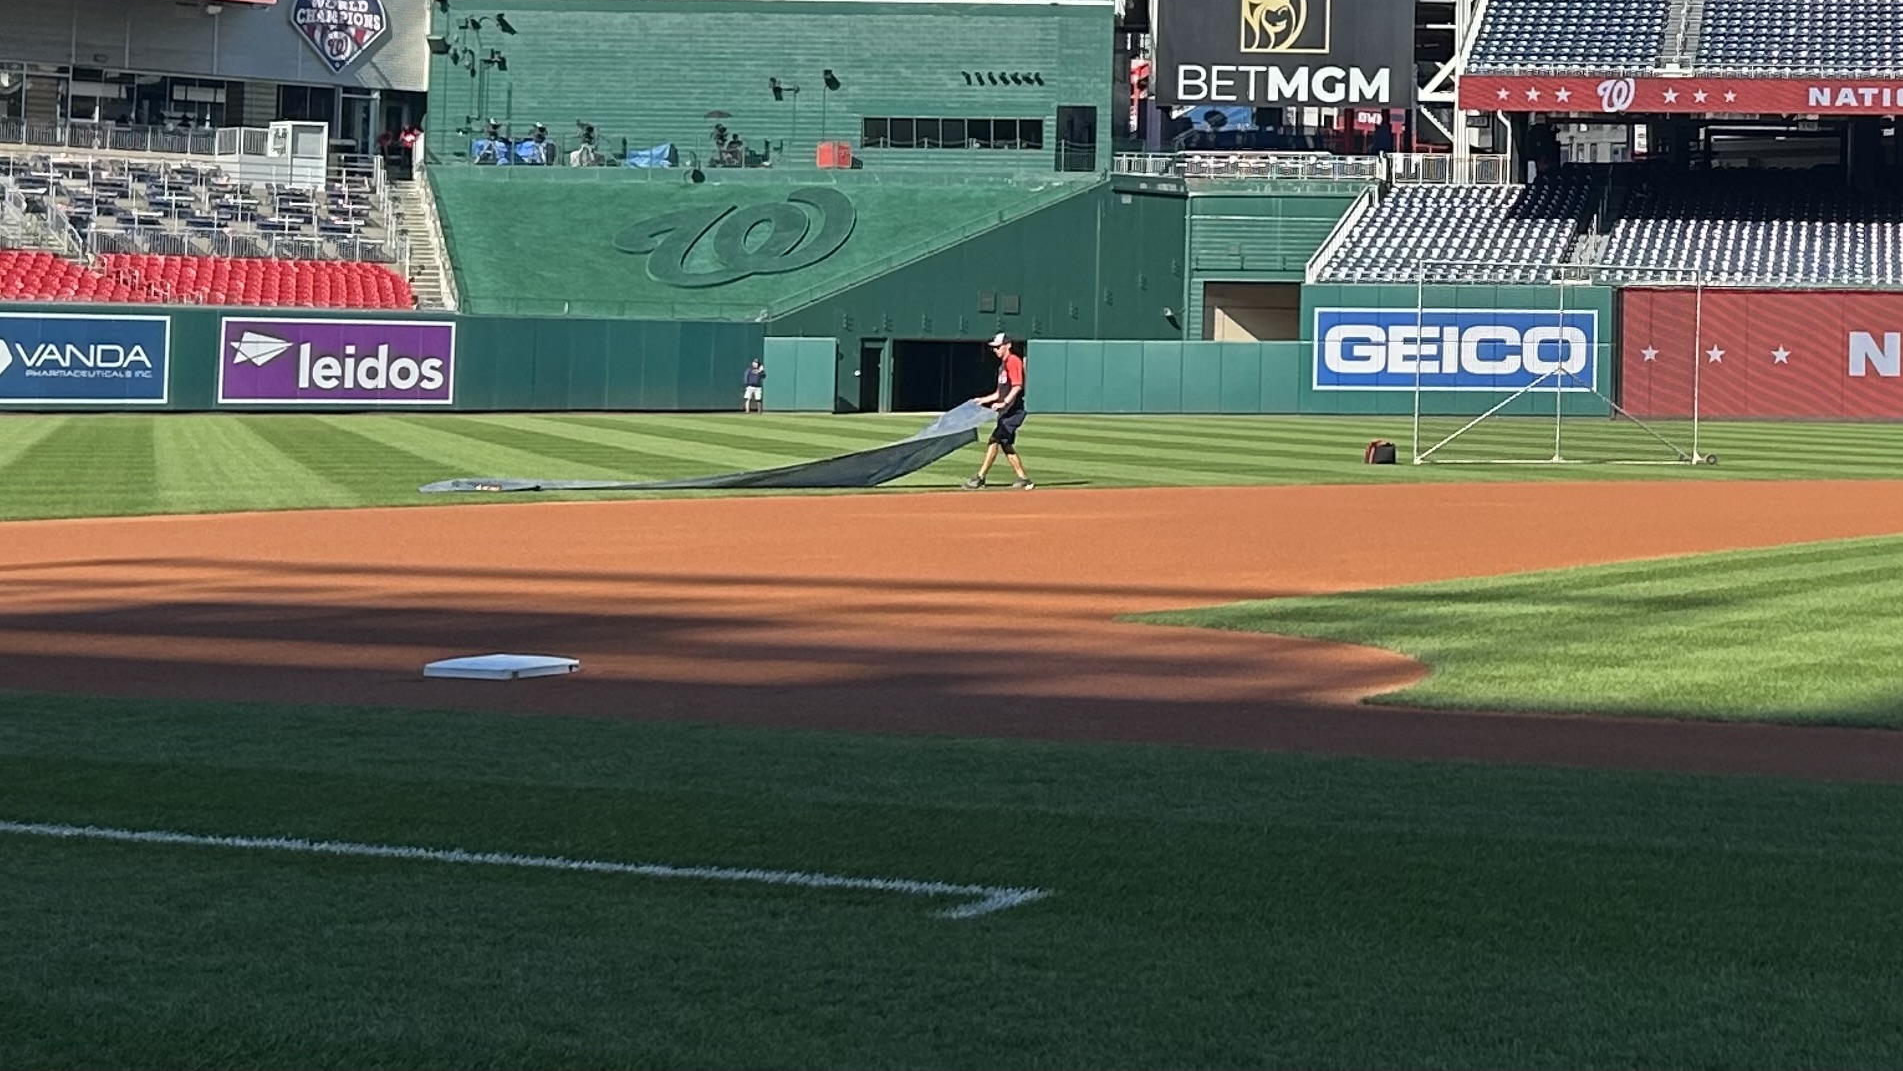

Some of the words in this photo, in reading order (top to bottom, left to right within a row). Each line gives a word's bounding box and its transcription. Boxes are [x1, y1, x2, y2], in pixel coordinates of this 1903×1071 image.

[297, 8, 381, 31] CHAMPIONS
[1177, 65, 1390, 103] BETMGM
[15, 343, 152, 368] VANDA
[299, 342, 444, 390] leidos
[1324, 324, 1587, 375] GEICO
